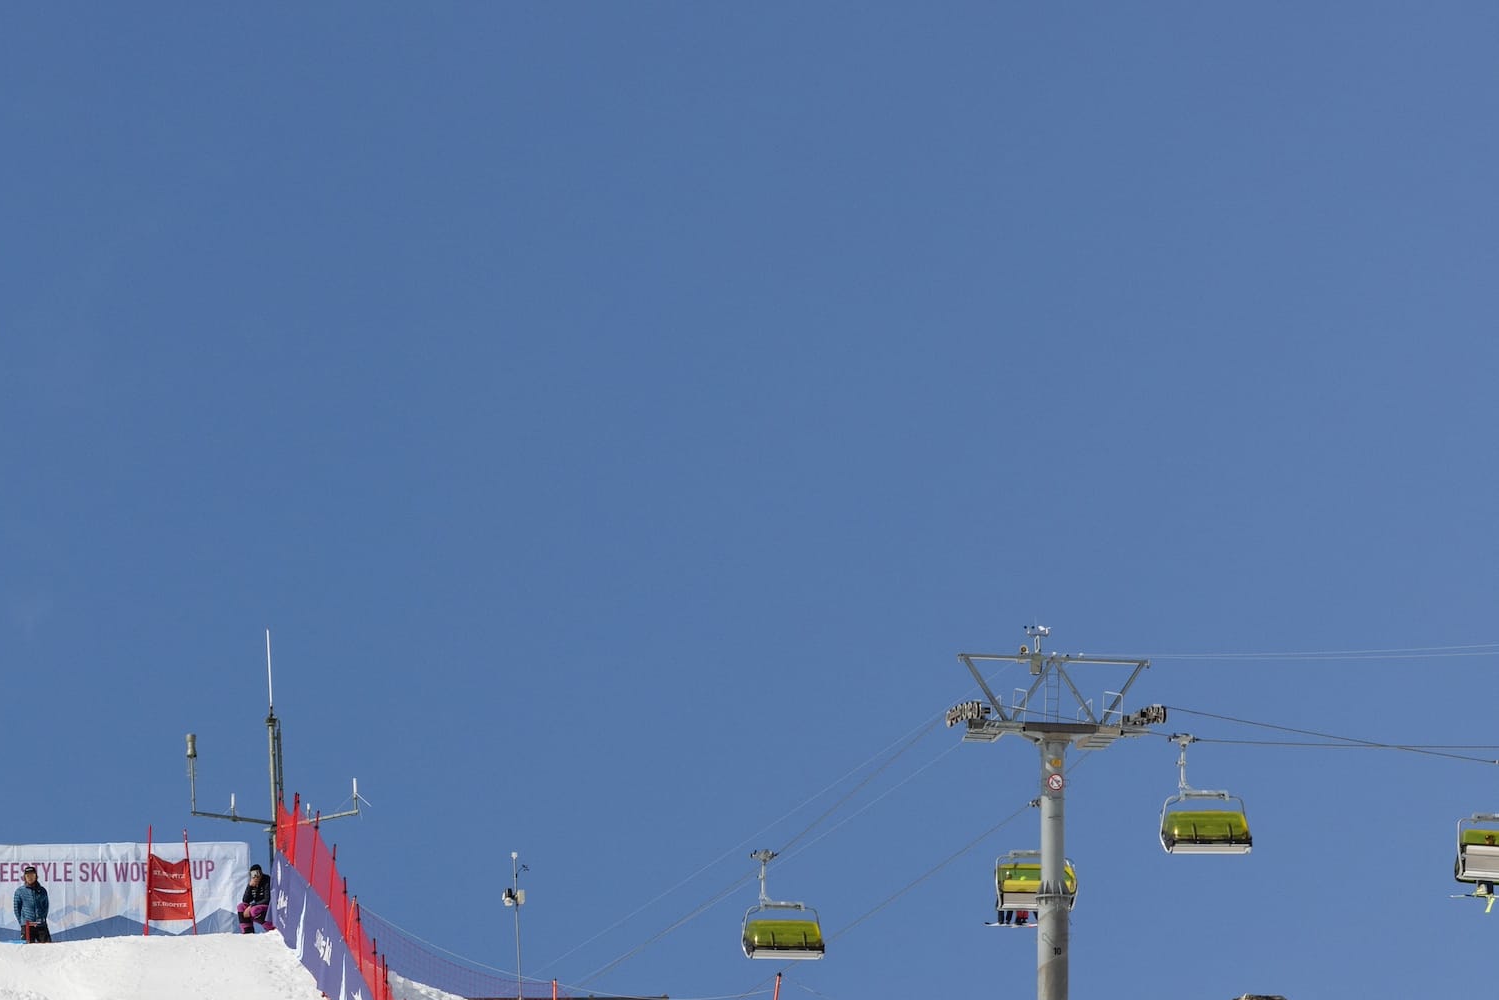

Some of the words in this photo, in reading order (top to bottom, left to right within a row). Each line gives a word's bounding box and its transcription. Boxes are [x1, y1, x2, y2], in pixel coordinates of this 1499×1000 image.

[79, 862, 107, 883] SKI
[114, 862, 148, 883] WOR
[193, 860, 214, 880] UP
[1053, 946, 1062, 956] 10
